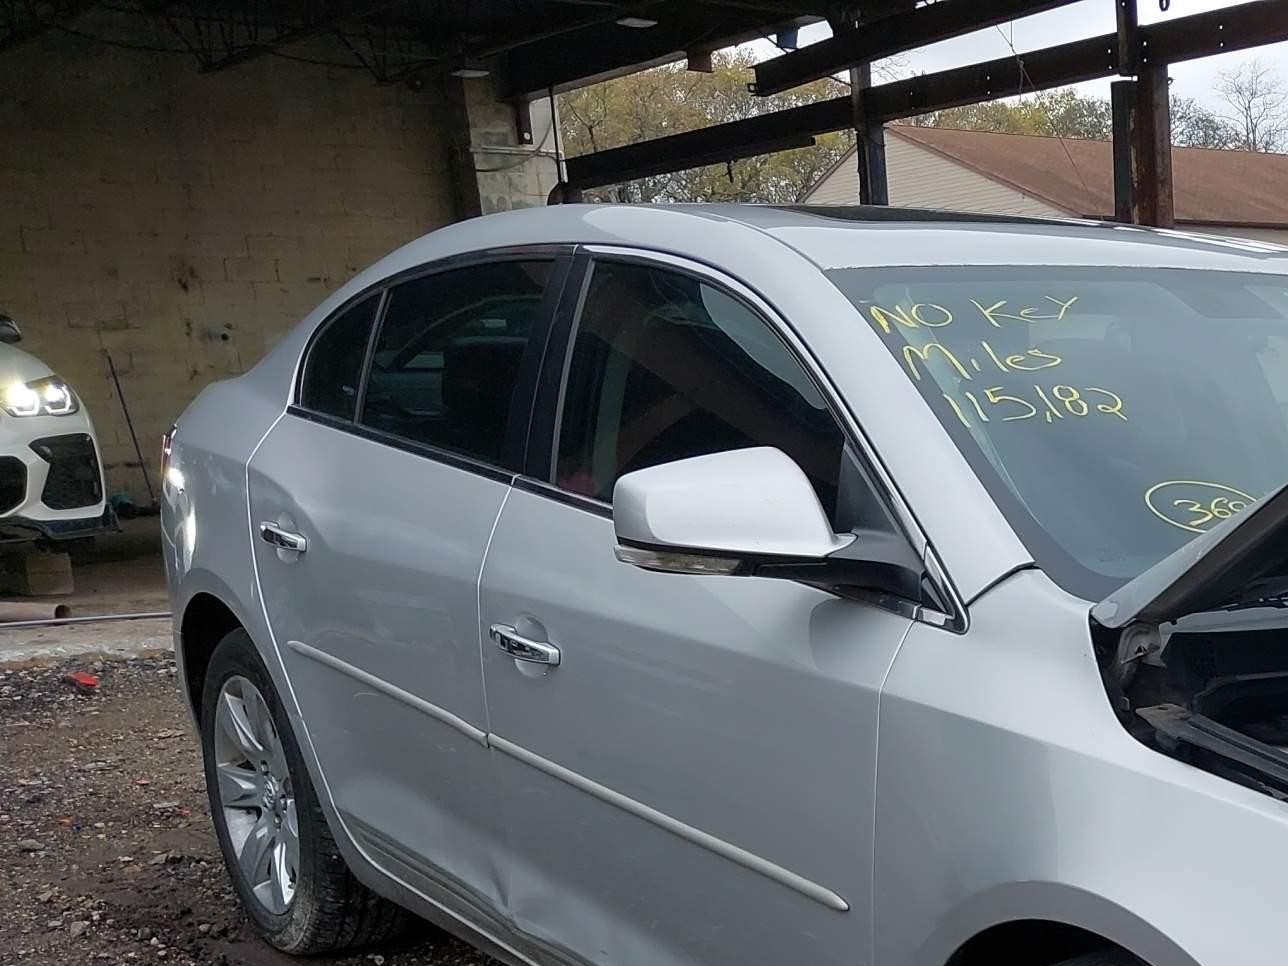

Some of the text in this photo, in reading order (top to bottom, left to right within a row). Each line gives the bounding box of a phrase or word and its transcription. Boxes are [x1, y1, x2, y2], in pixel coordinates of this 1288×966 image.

[870, 303, 953, 333] NO
[902, 340, 1062, 381] Miles
[943, 384, 1128, 428] 115,182
